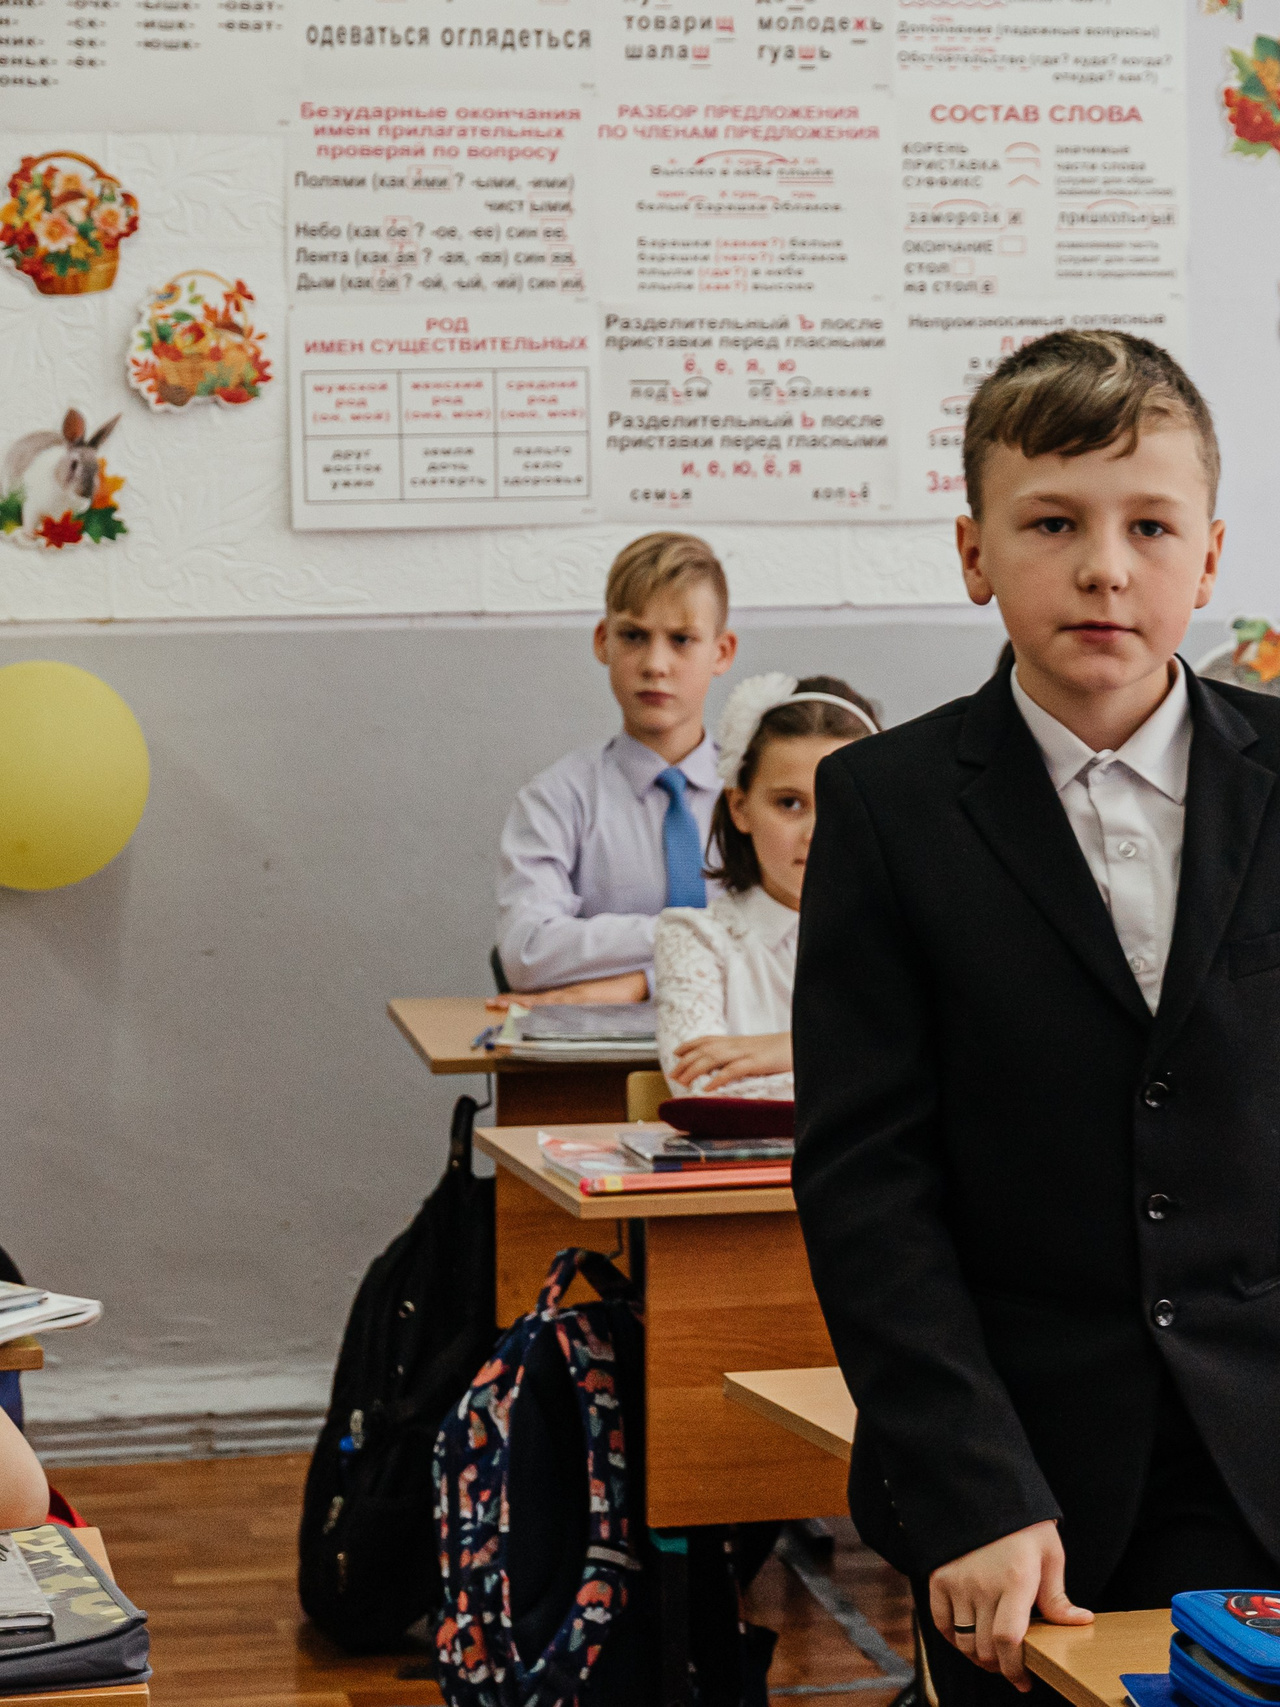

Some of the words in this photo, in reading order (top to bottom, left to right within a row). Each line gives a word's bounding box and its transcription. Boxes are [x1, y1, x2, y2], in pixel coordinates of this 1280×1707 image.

[624, 15, 735, 35] товарищ
[757, 16, 885, 34] молодежь
[305, 24, 431, 49] одеваться
[440, 26, 592, 51] оглядеться
[624, 45, 711, 60] шалаш
[757, 45, 832, 65] гуашь
[300, 102, 448, 122] Безударные
[455, 106, 582, 120] окончания
[617, 104, 698, 119] РАЗБОР
[703, 104, 860, 121] ПРЕДЛОЖЕНИЯ
[930, 104, 1040, 123] СОСТАВ
[1048, 104, 1144, 123] СЛОВА
[313, 125, 370, 138] имен
[377, 125, 565, 141] прилагательных
[597, 125, 628, 140] ПО
[633, 125, 718, 139] ЧЛЕНАМ
[724, 125, 881, 142] ПРЕДЛОЖЕНИЯ
[316, 143, 425, 160] проверяй
[432, 145, 460, 158] по
[466, 146, 560, 162] вопросу
[902, 158, 1000, 172] ПРИСТАВКА
[294, 171, 367, 188] Полями
[902, 174, 983, 188] СУФФИКС
[295, 221, 342, 238] Небо
[296, 247, 349, 264] Лента
[296, 273, 336, 291] Дым
[425, 316, 469, 333] РОД
[605, 313, 790, 331] Разделительный
[820, 318, 885, 330] после
[303, 338, 365, 354] ИМЕН
[370, 335, 589, 354] СУЩЕСТВИТЕЛЬНЫХ
[605, 336, 713, 352] приставки
[719, 336, 780, 350] перед
[785, 336, 887, 348] гласными
[778, 358, 797, 374] ю
[608, 410, 794, 430] Разделительный
[821, 415, 886, 427] после
[606, 433, 713, 450] приставки
[719, 434, 782, 451] перед
[787, 433, 889, 447] гласными
[789, 460, 803, 475] я
